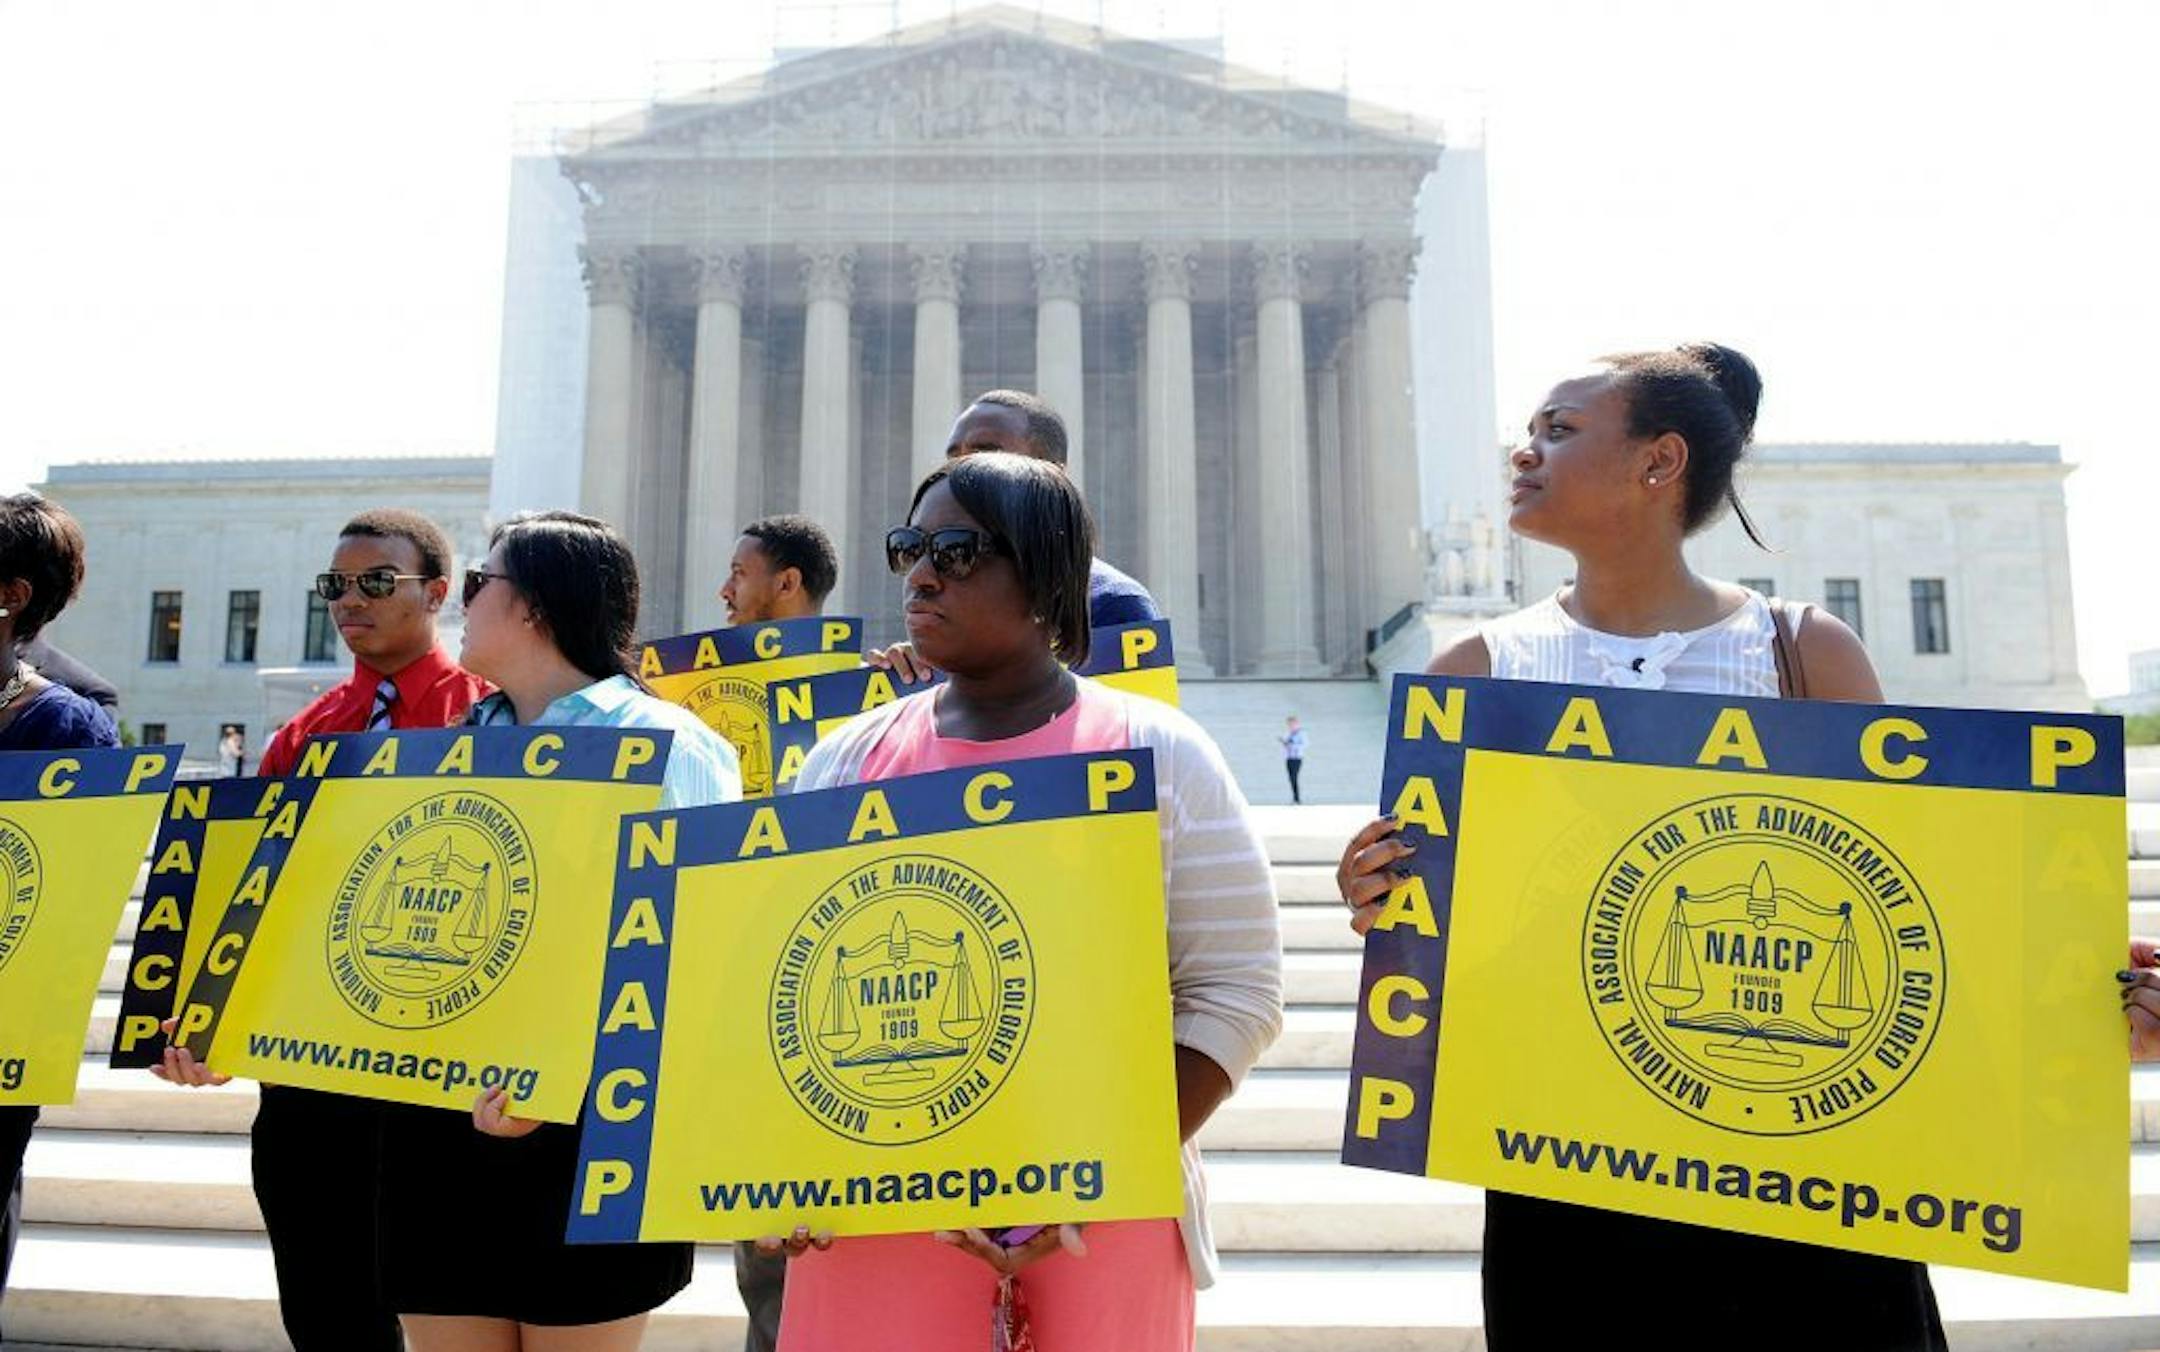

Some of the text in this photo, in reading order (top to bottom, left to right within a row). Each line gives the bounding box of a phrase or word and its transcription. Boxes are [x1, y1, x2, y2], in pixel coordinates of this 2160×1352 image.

[297, 735, 655, 779] NAACP
[1403, 686, 2097, 787] NAACP
[628, 760, 1136, 868] NAACP
[1695, 805, 1738, 835] THE
[1641, 822, 1688, 862] FOR
[1756, 805, 1913, 910] ADVANCEMENT
[333, 797, 530, 1020] NATIONAL ASSOCIATION FOR THE ADVANCEMENT OF COLORED PEOPLE
[398, 885, 463, 913] NAACP
[1592, 860, 1646, 1004] ASSOCIATION
[1705, 930, 1813, 973] NAACP
[1898, 924, 1930, 952] OF
[776, 863, 1026, 1133] NATIONAL ASSOCIATION FOR THE ADVANCEMENT OF COLORED PEOPLE
[860, 970, 939, 1006] NAACP
[1731, 988, 1783, 1014] 1909
[1733, 972, 1781, 989] FOUNDED
[880, 1020, 918, 1040] 1909
[1874, 969, 1933, 1070] COLORED
[247, 1033, 540, 1100] www.naacp.org
[1612, 1017, 1711, 1110] NATIONAL
[1788, 1067, 1878, 1123] PEOPLE
[700, 1159, 1104, 1212] www.naacp.org
[1496, 1127, 2023, 1254] www.naacp.org
